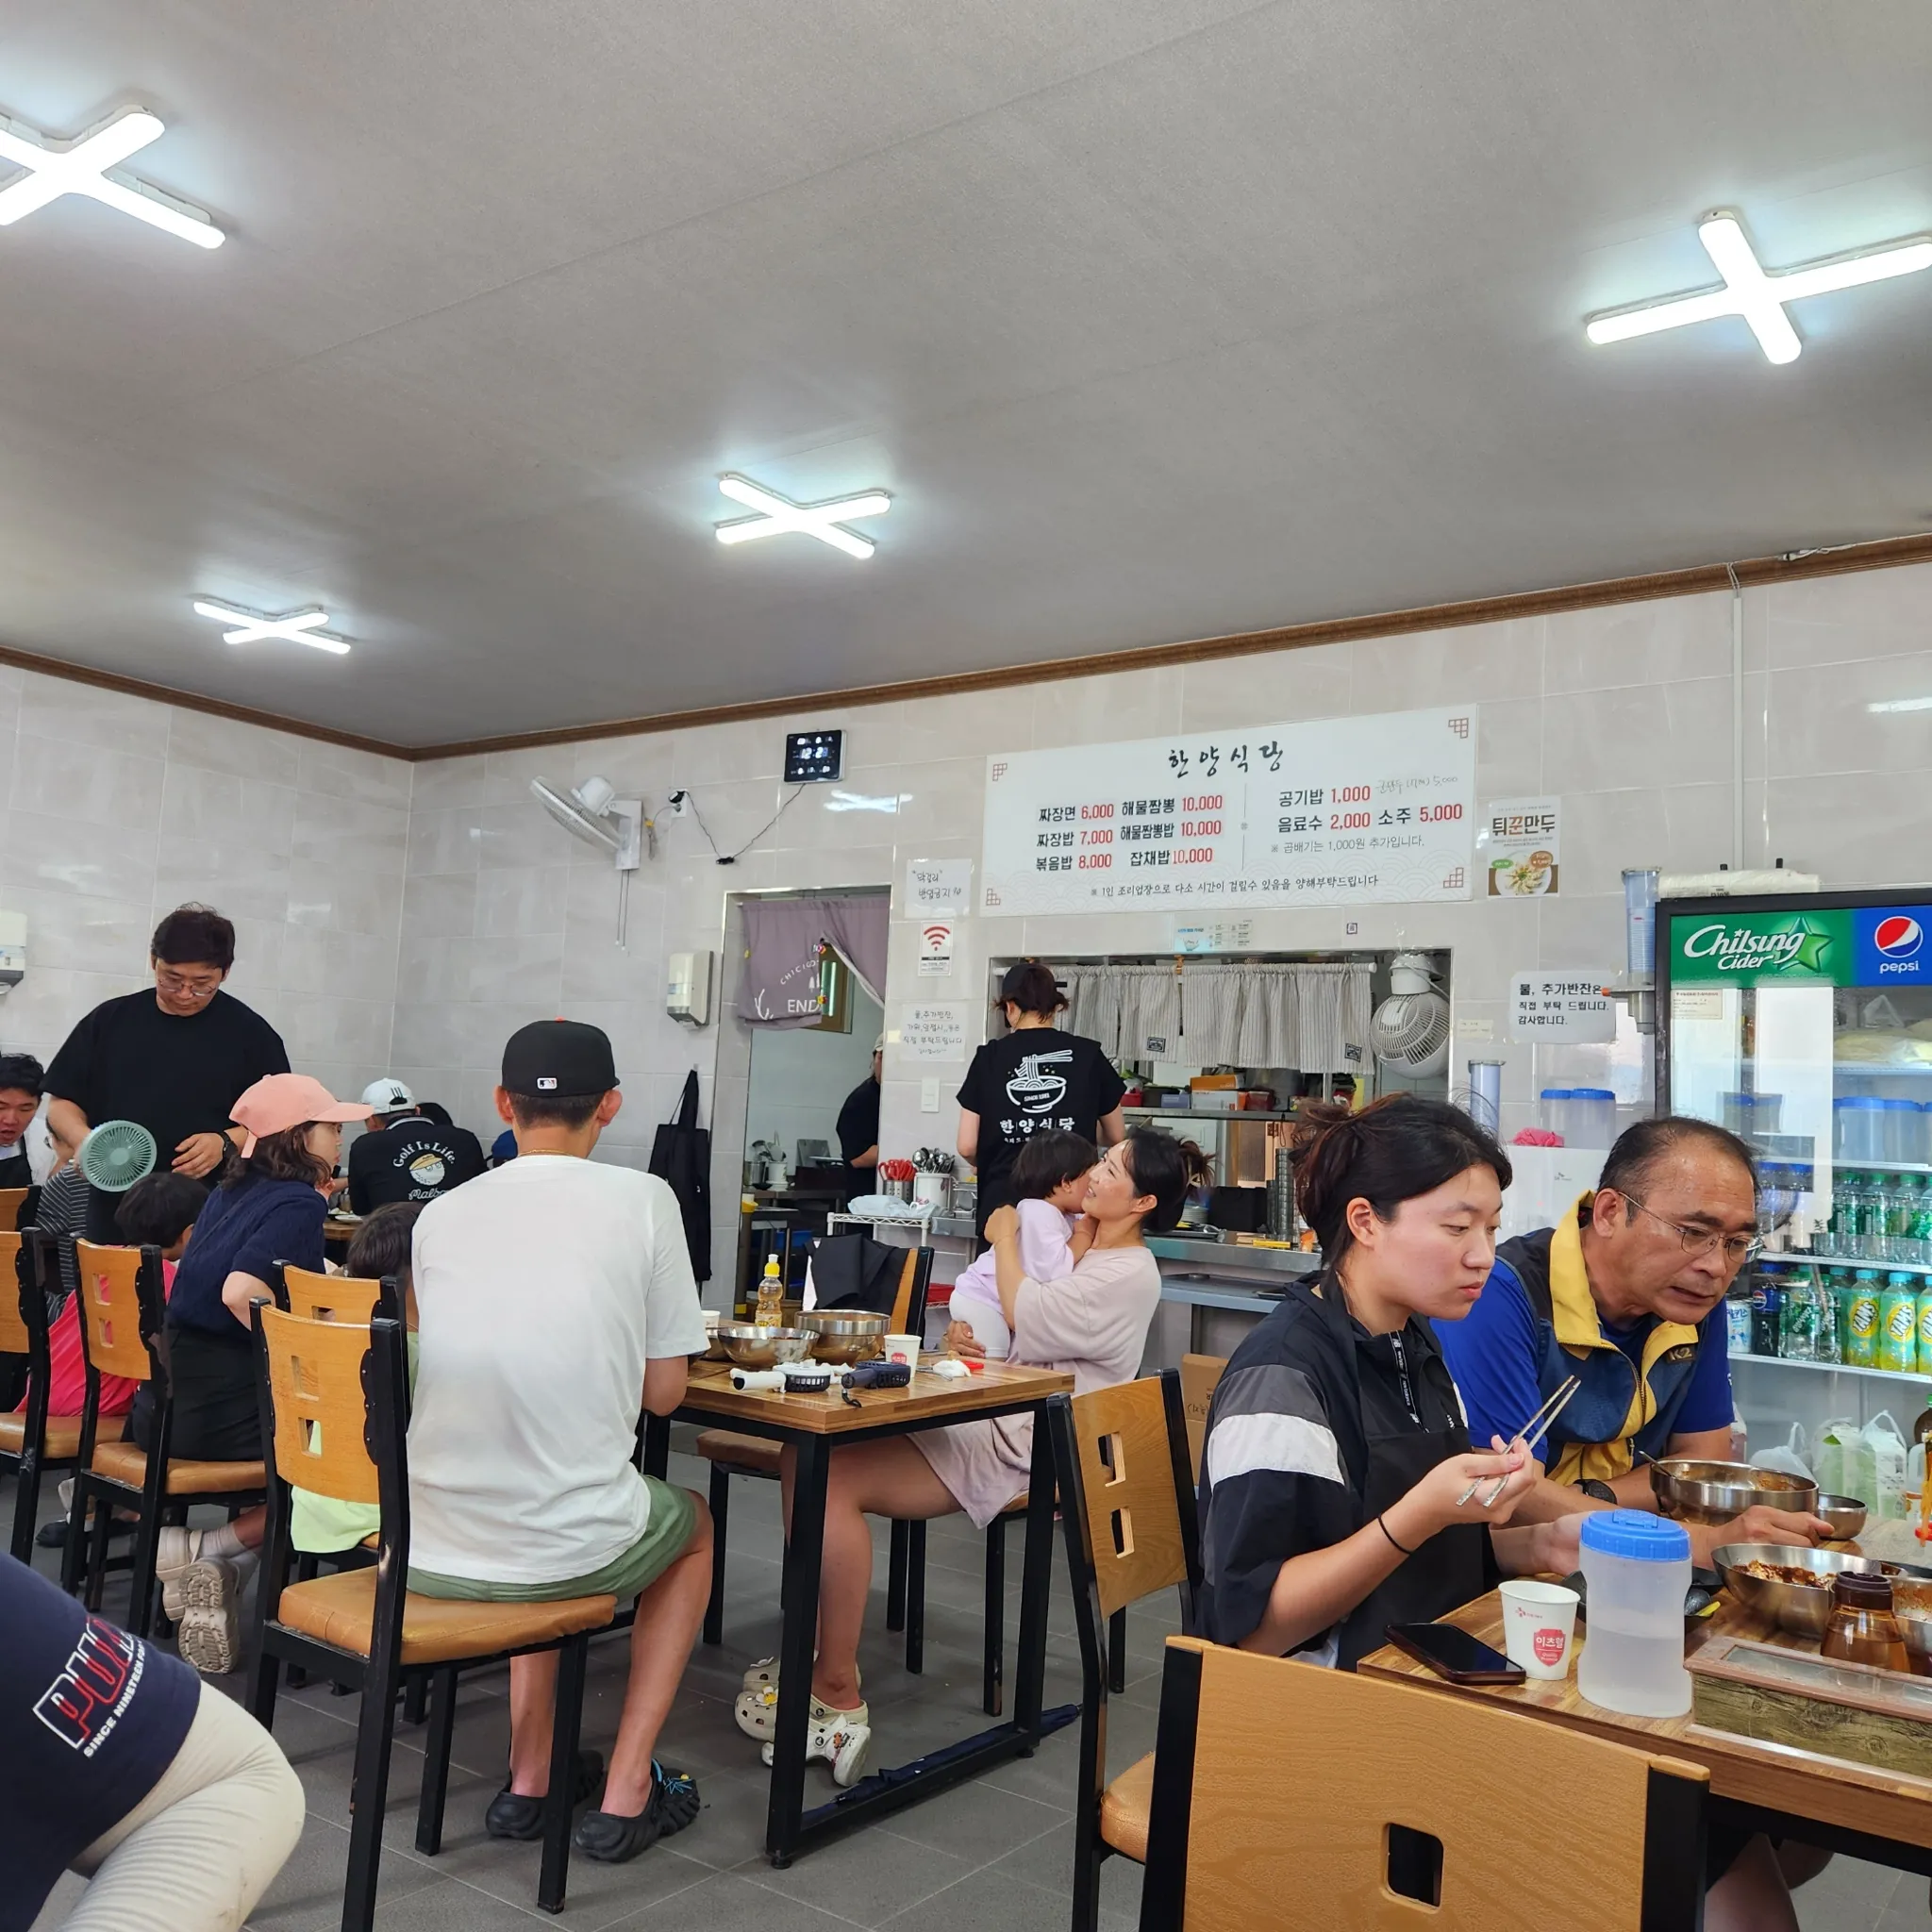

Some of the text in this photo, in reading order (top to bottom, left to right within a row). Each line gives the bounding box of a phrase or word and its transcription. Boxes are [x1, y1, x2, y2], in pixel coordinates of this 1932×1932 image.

[1122, 794, 1223, 816] 해물짬뽕 10,000
[1278, 785, 1371, 808] 공기밥 1,000
[1039, 804, 1114, 822] 짜장면 6,000
[1277, 812, 1371, 833] 음료수 2,000
[1419, 803, 1462, 823] 5,000
[1037, 829, 1113, 847] 짜장밥 7,000
[1120, 820, 1222, 841] 해물짬뽕밥 10,000
[1328, 838, 1365, 851] 1,000원
[1369, 835, 1424, 849] 추가입니다.
[1037, 854, 1112, 872] 볶음밥 8,000
[1130, 847, 1213, 867] 잡채밥 10,000
[1102, 886, 1114, 896] 1인
[1174, 883, 1193, 893] 다소
[1197, 881, 1224, 893] 시간이
[1228, 879, 1257, 892] 걸릴수
[1261, 878, 1291, 891] 있음을
[1295, 874, 1378, 890] 양해부탁드립니다
[1684, 924, 1806, 963] Chilsung
[1717, 954, 1774, 971] Cider
[1879, 960, 1920, 974] pepsi
[1519, 983, 1535, 996] 물,
[1519, 1001, 1609, 1011] 직접 부탁 드립니다.
[1518, 1015, 1568, 1025] 감사합니다.
[392, 1141, 456, 1167] Golf Is Life.
[1668, 1347, 1692, 1361] K2
[83, 1716, 117, 1758] SINCE
